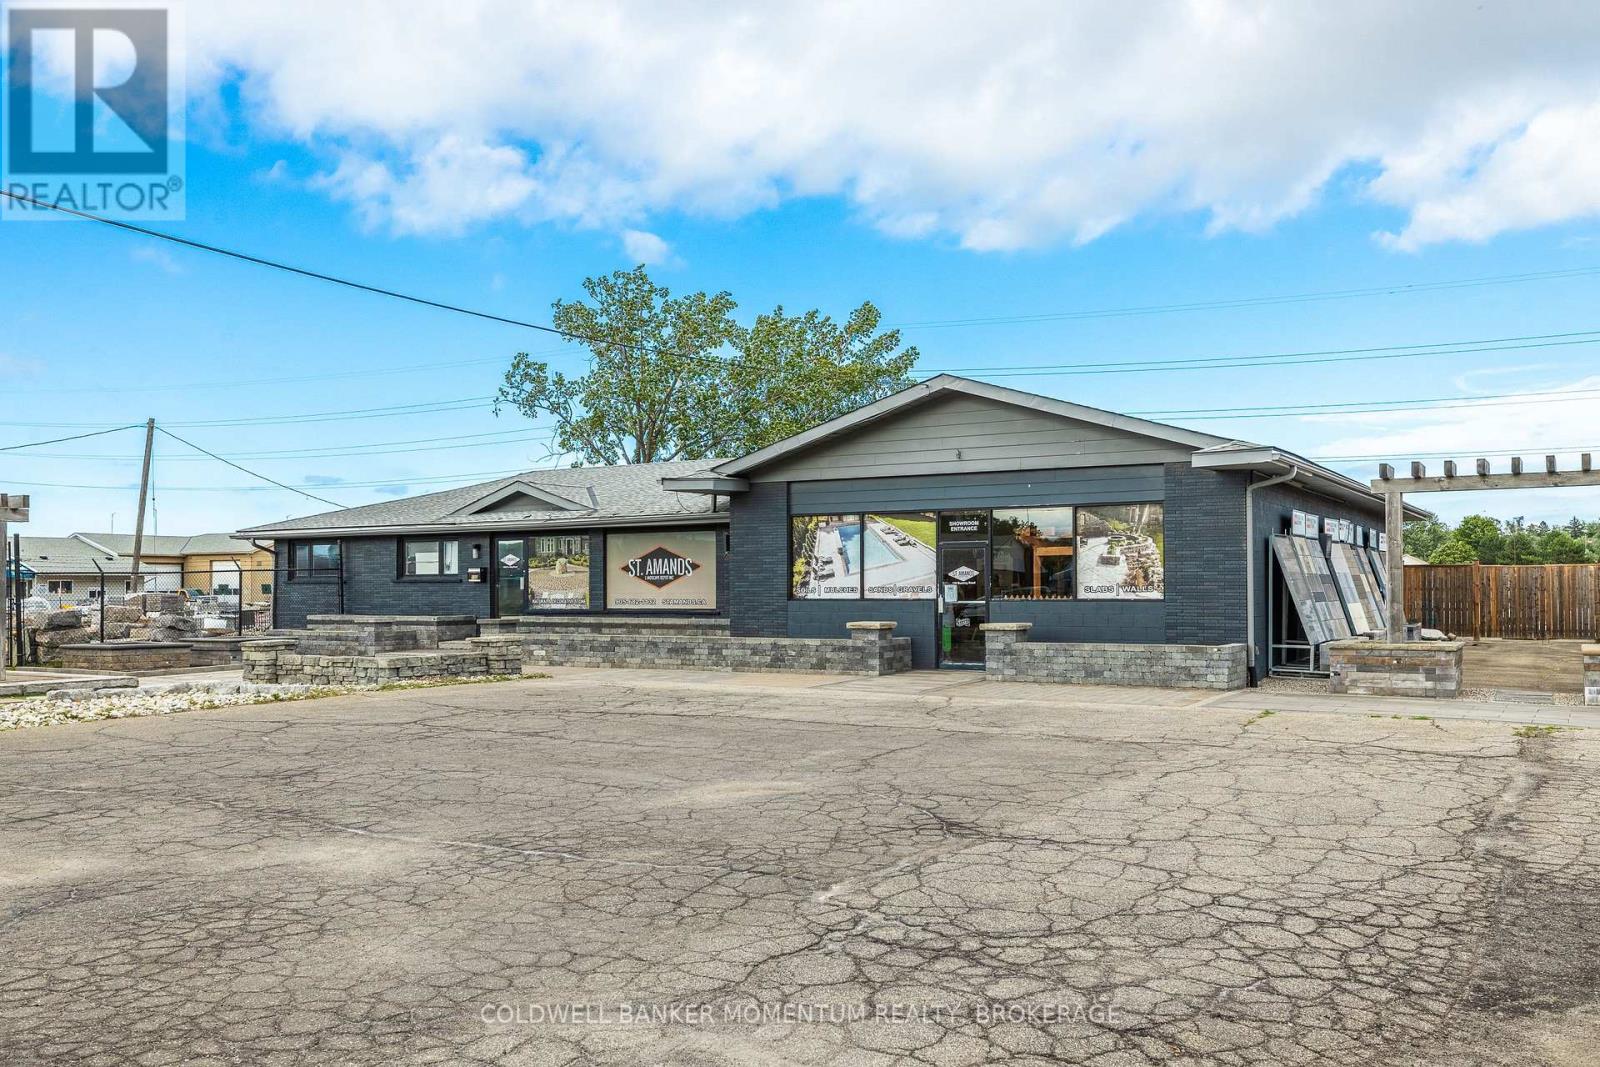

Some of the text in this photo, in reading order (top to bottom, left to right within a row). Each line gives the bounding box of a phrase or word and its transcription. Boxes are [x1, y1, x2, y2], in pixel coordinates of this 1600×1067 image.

[628, 557, 693, 577] ST. AMANDS
[867, 585, 934, 594] SANDS GRAVELS
[1083, 585, 1155, 594] SLABS WALLS
